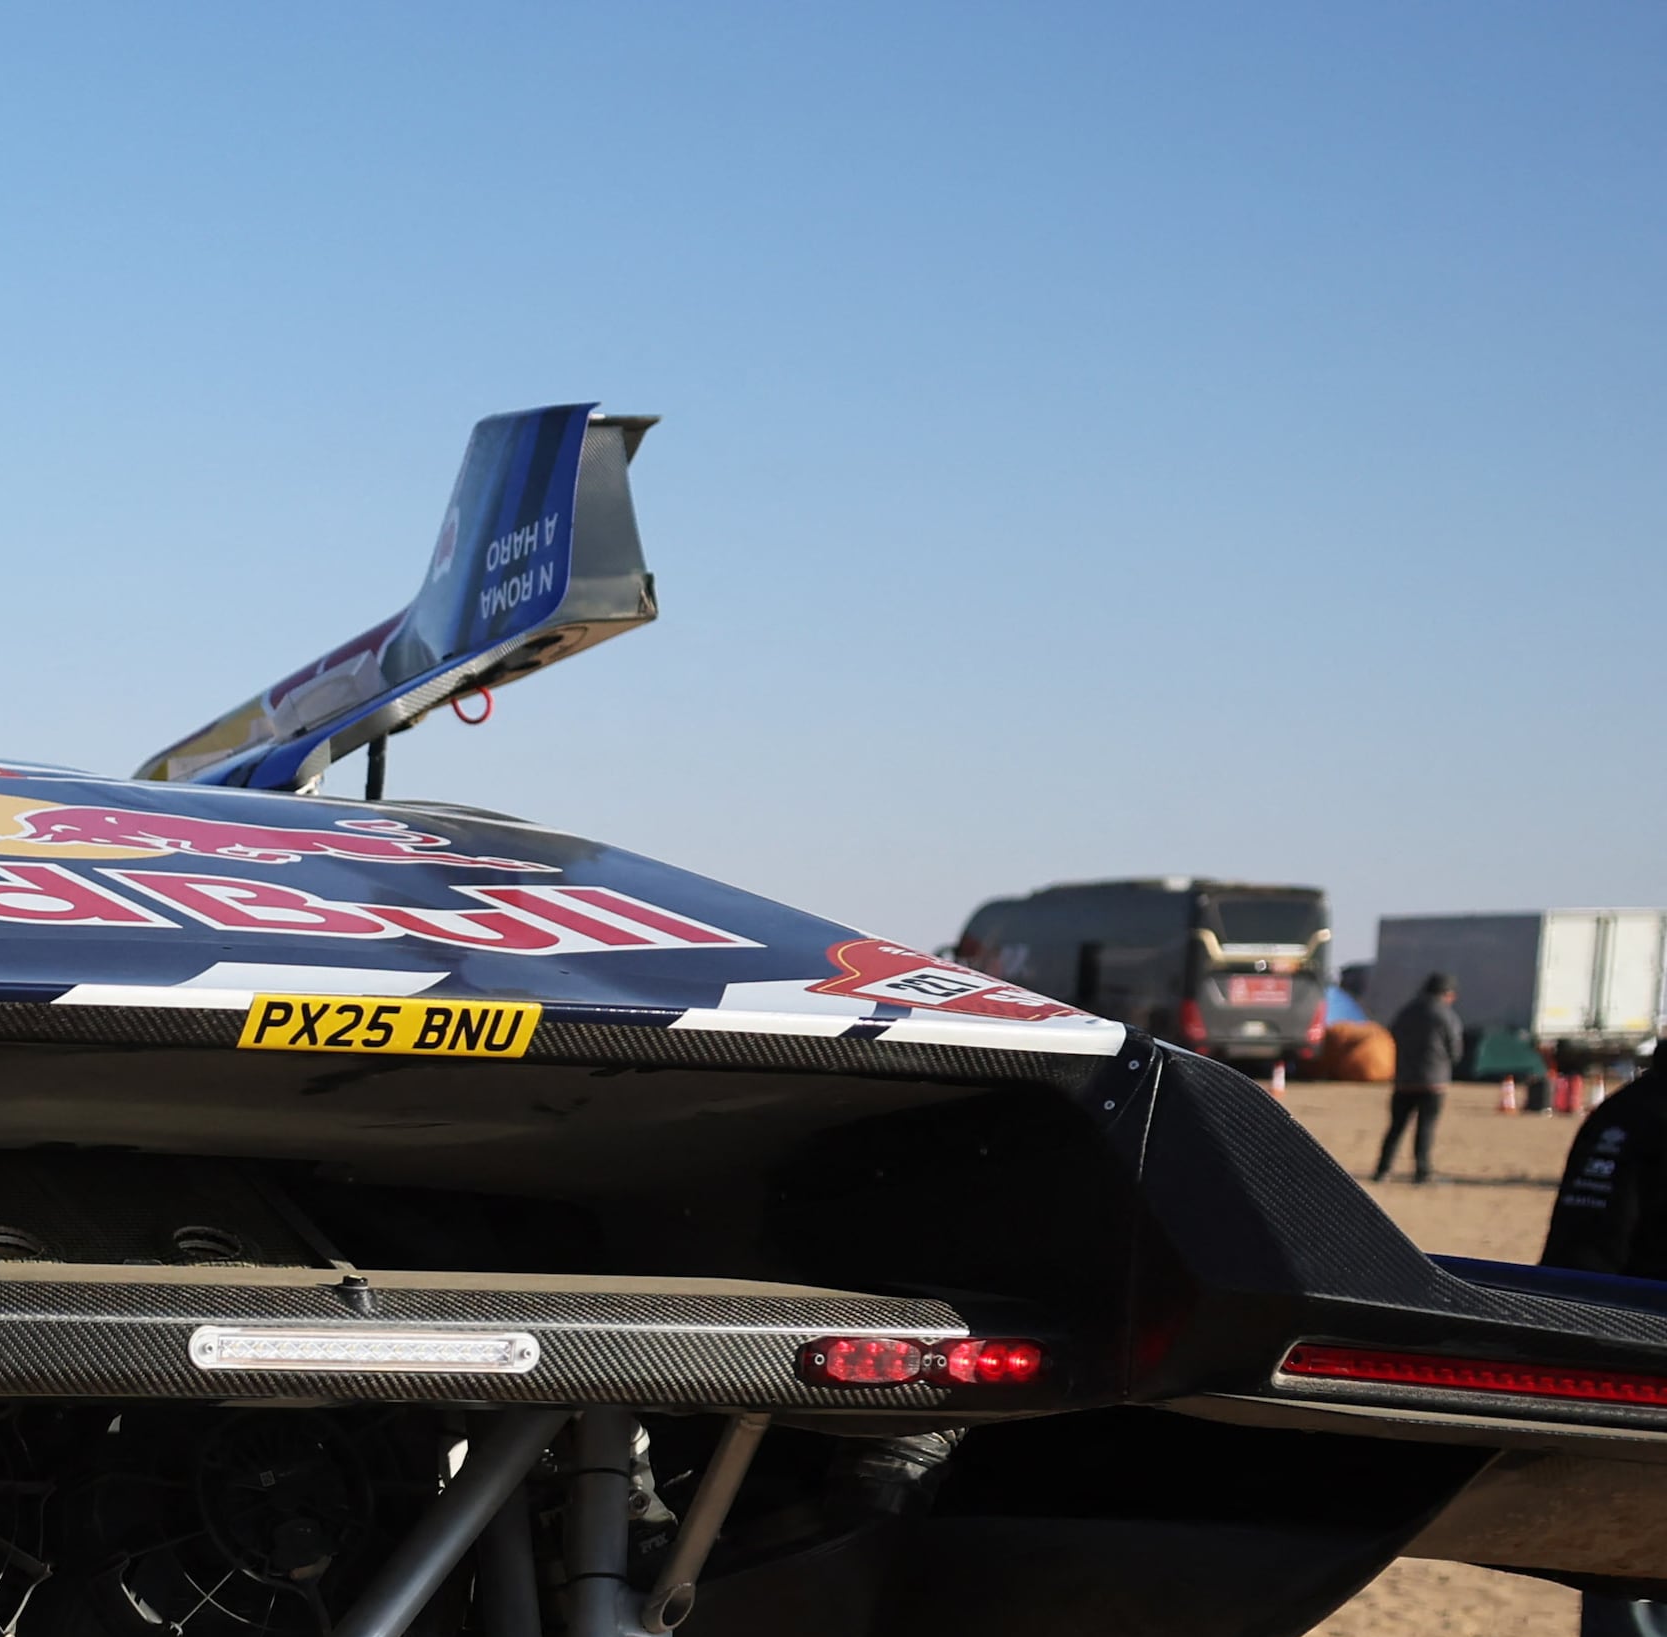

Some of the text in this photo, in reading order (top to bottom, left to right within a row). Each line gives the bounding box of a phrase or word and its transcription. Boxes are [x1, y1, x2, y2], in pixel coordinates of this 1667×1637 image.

[486, 513, 559, 571] A HARO
[480, 562, 554, 619] N ROMA
[94, 867, 768, 956] Bull
[253, 1001, 527, 1053] PX25 BNU
